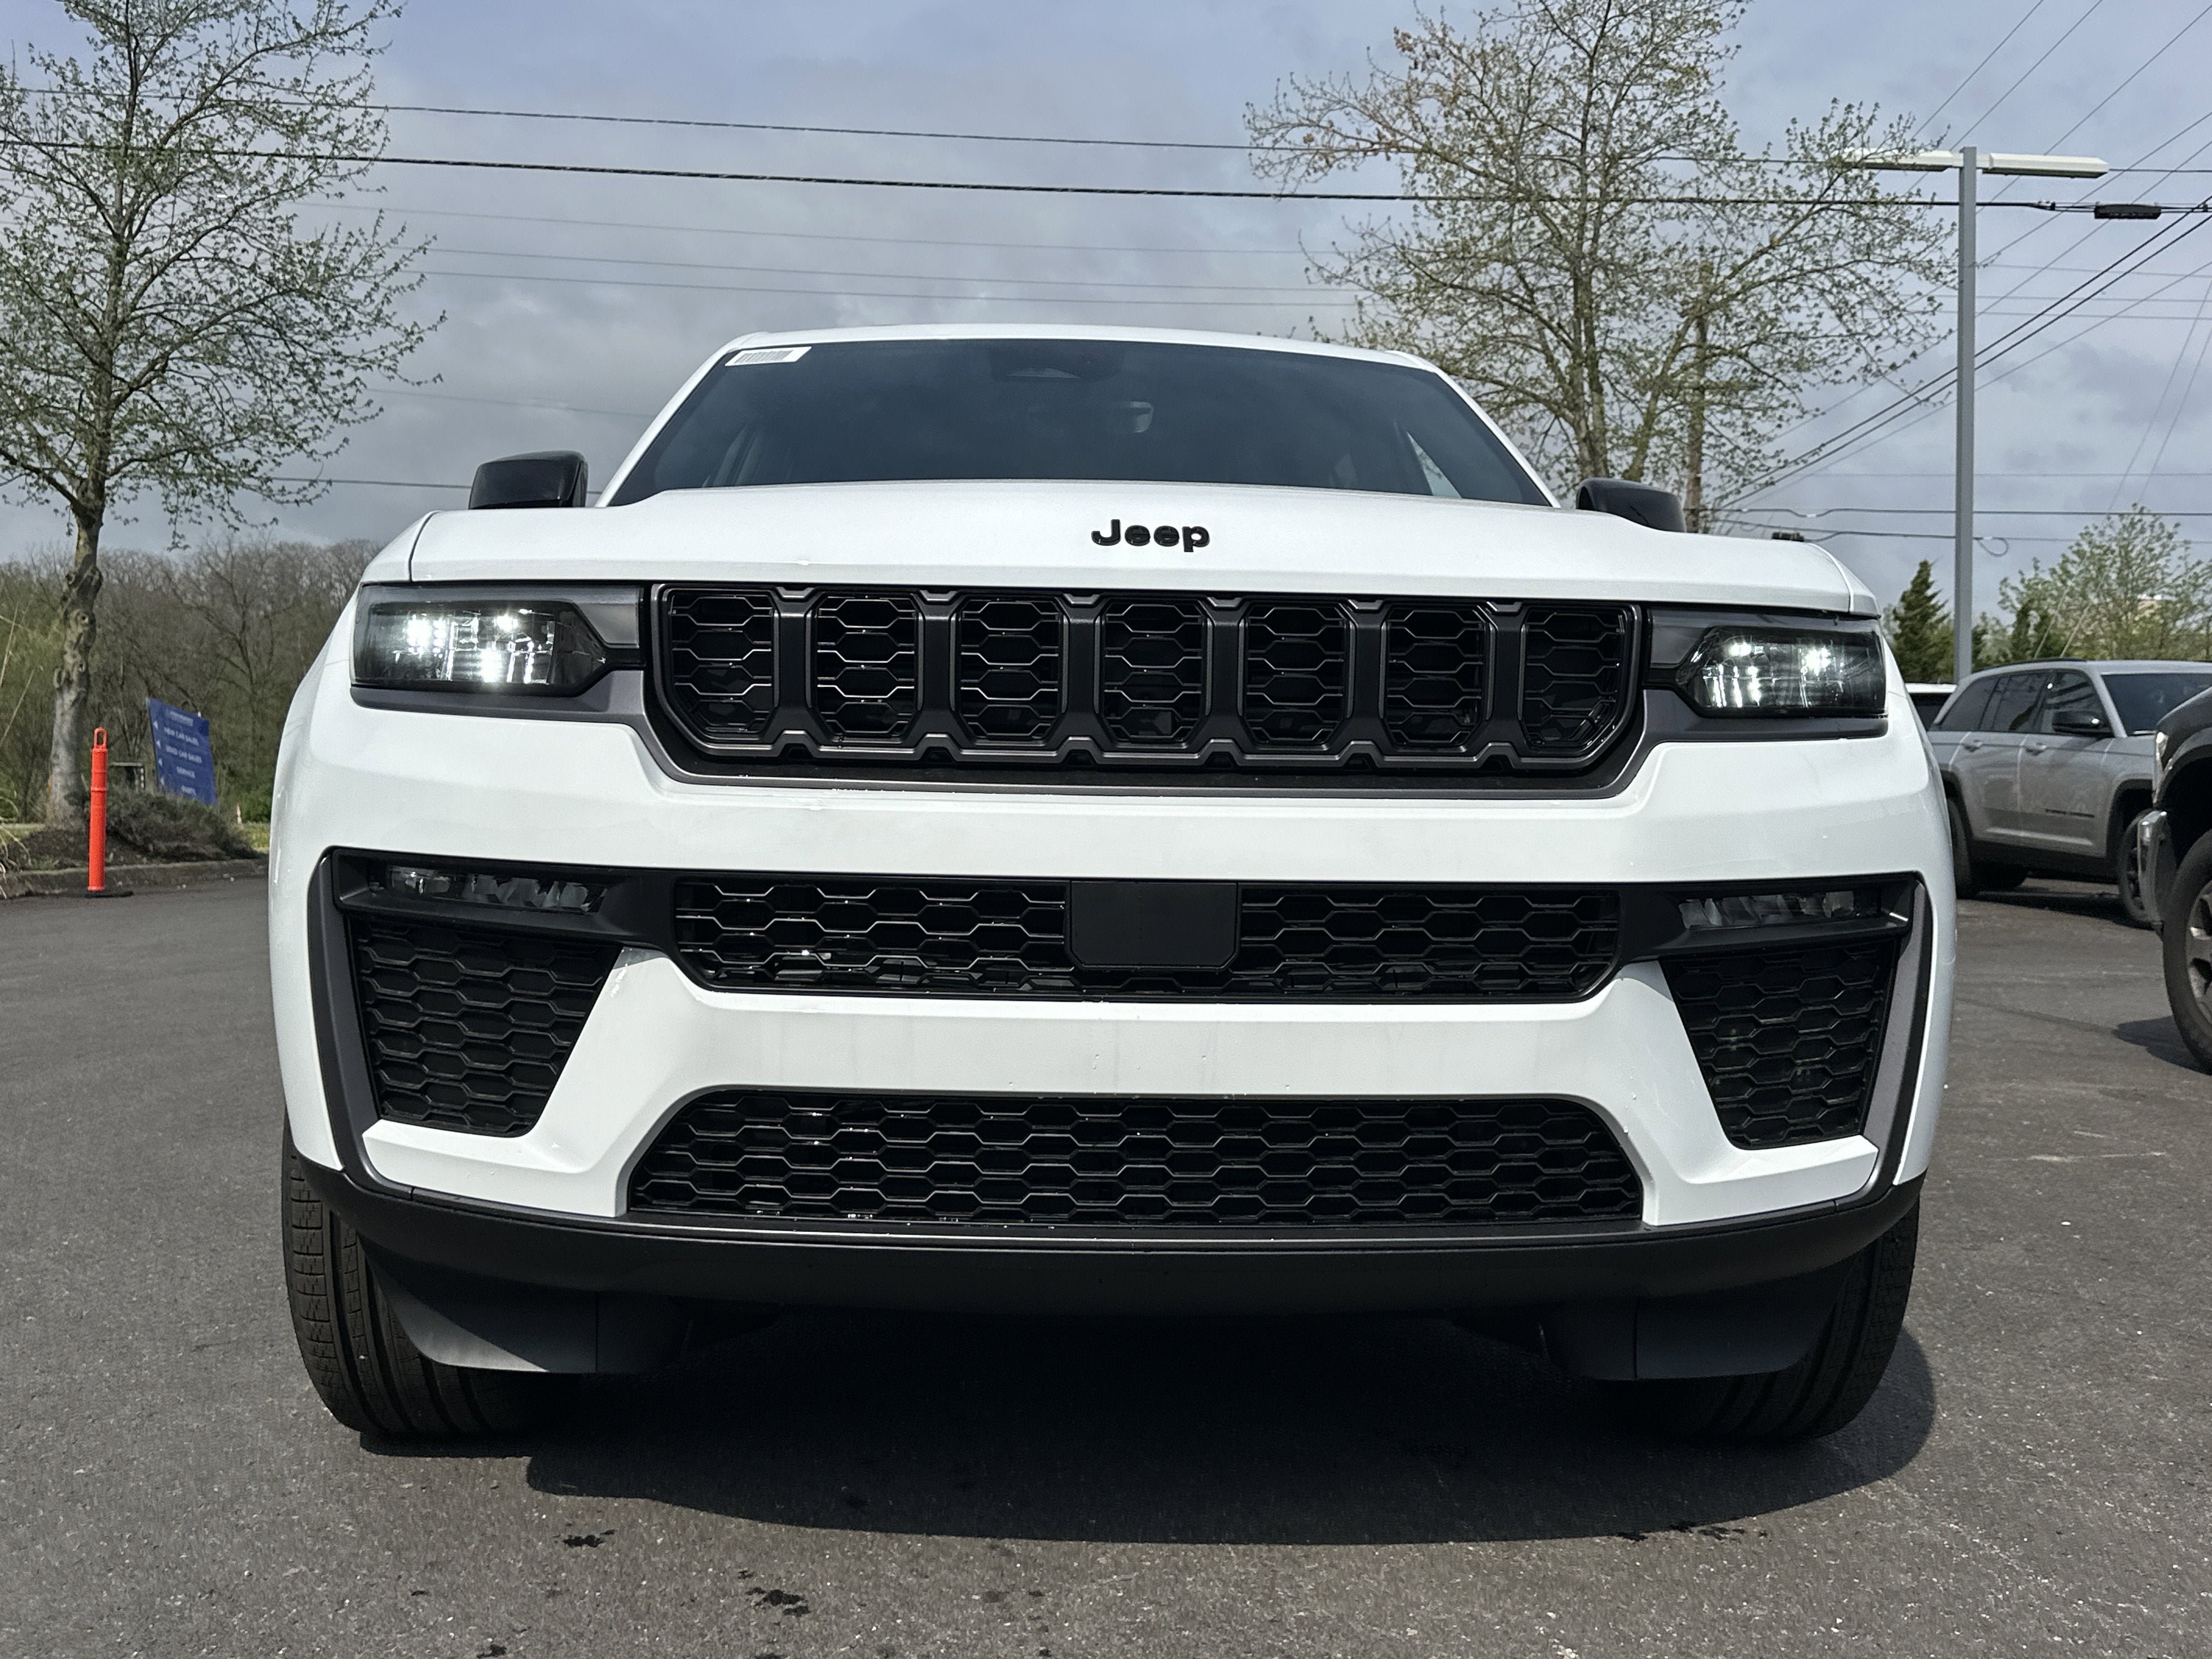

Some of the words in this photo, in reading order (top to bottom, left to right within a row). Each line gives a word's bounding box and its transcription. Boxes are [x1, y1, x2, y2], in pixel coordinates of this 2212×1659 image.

[1091, 519, 1210, 552] Jeep
[176, 731, 185, 740] CAR
[185, 735, 199, 746] SALES
[166, 745, 178, 755] USED
[178, 749, 188, 758] CAR
[188, 753, 202, 764] SALES
[176, 766, 195, 778] SERVICE
